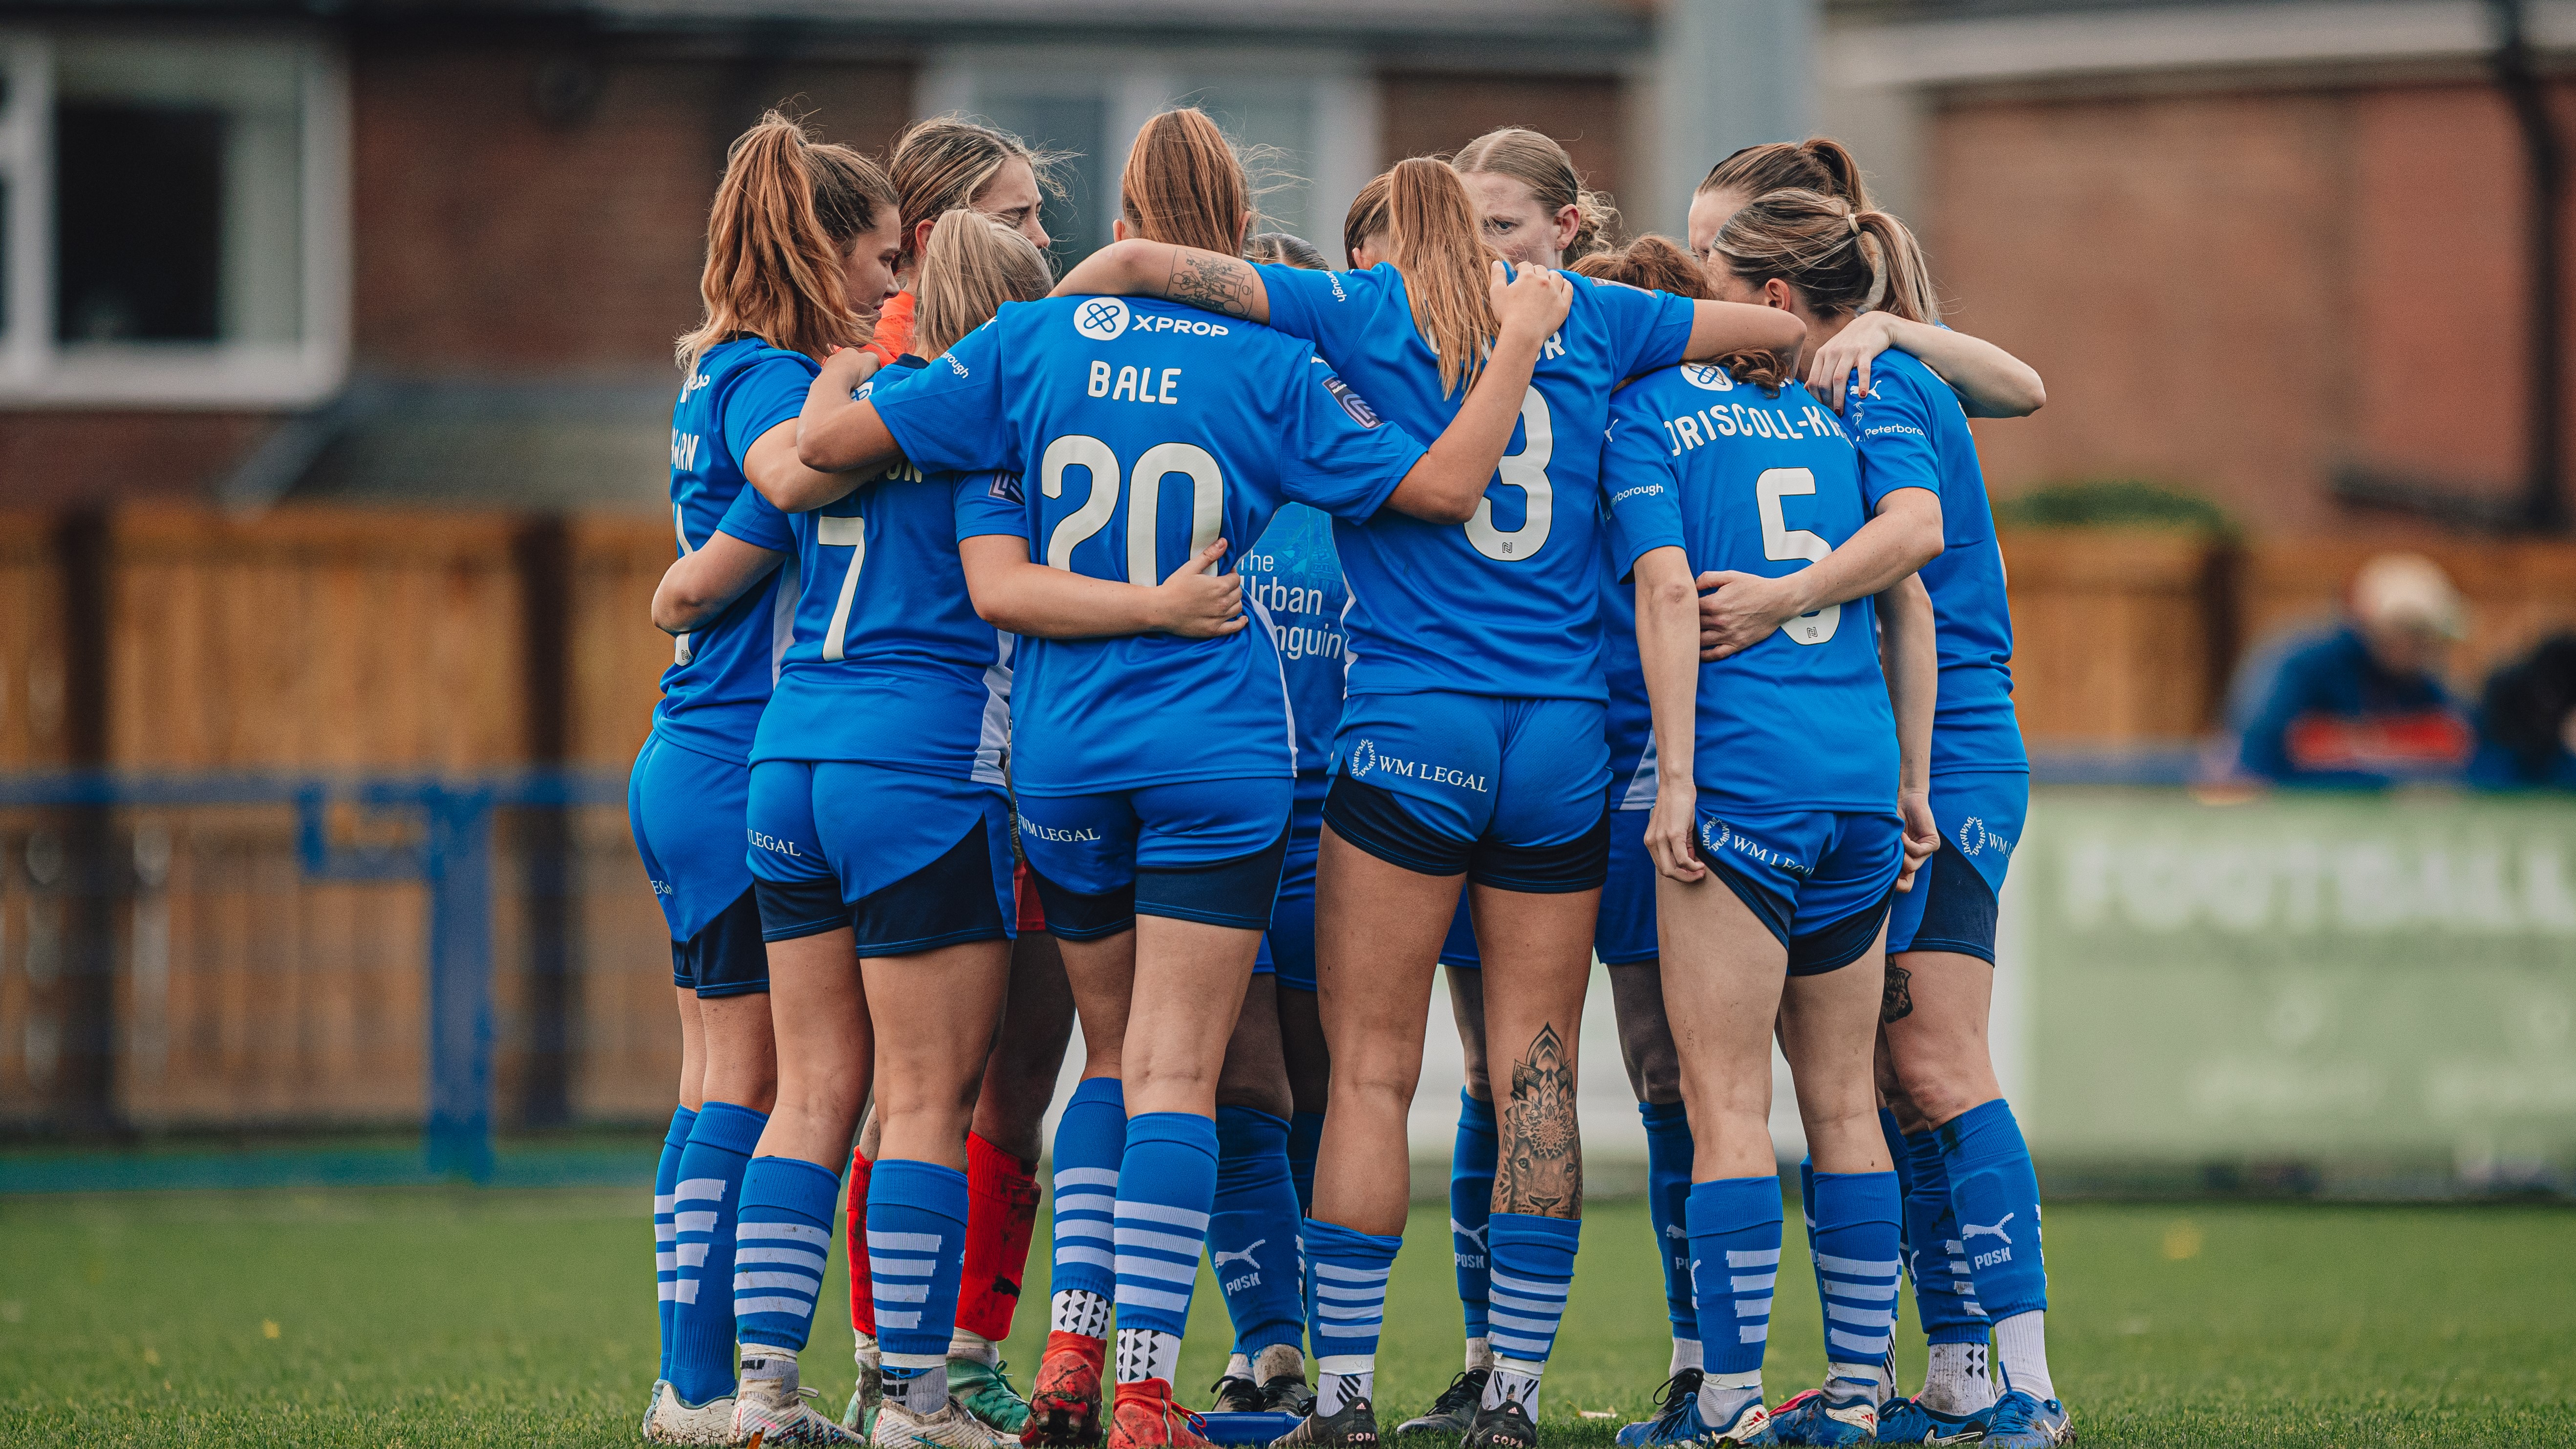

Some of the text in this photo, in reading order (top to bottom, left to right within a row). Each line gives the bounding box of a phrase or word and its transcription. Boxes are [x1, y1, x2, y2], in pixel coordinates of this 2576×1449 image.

[1132, 315, 1229, 337] XPROP
[1087, 360, 1182, 405] BALE
[1865, 423, 1926, 439] Peterboro
[1464, 384, 1553, 561] 3
[1041, 434, 1224, 587] 20
[1756, 467, 1841, 645] 5
[817, 516, 866, 662] 7
[1379, 755, 1488, 793] WM LEGAL
[1020, 814, 1038, 837] WM
[1038, 825, 1100, 842] LEGAL
[749, 829, 801, 856] LEGAL
[1735, 835, 1769, 861] WM
[1988, 832, 2008, 854] WM
[1455, 1252, 1485, 1269] POSH
[1974, 1247, 2013, 1270] POSH
[1226, 1272, 1261, 1296] POSH
[1347, 1432, 1376, 1442] COPA
